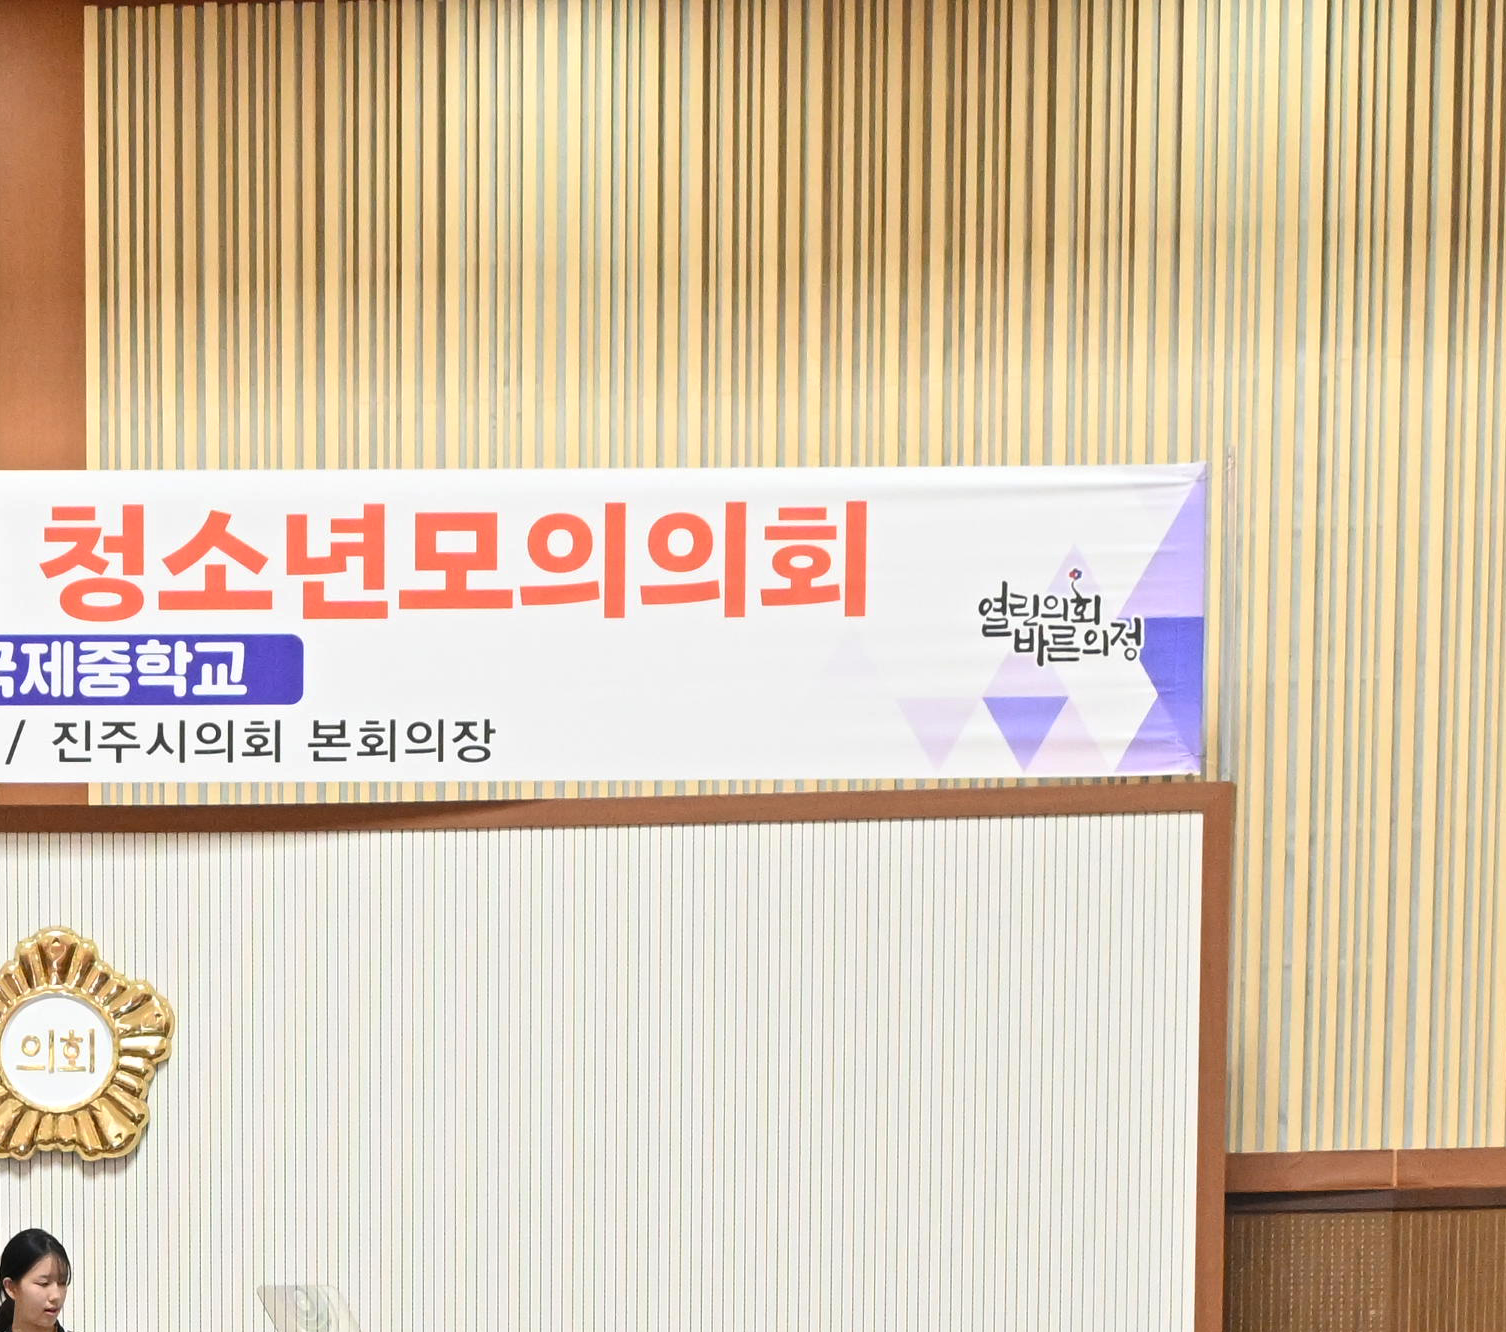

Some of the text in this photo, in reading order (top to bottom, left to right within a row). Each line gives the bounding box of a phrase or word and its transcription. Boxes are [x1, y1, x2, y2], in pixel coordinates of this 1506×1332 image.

[38, 500, 868, 623] 청소년모의의회
[978, 580, 1102, 637] 열린의회
[1013, 615, 1142, 667] 바른의정
[51, 718, 287, 767] 진주시의회
[307, 717, 498, 767] 본회의장
[15, 1028, 95, 1074] 의회
